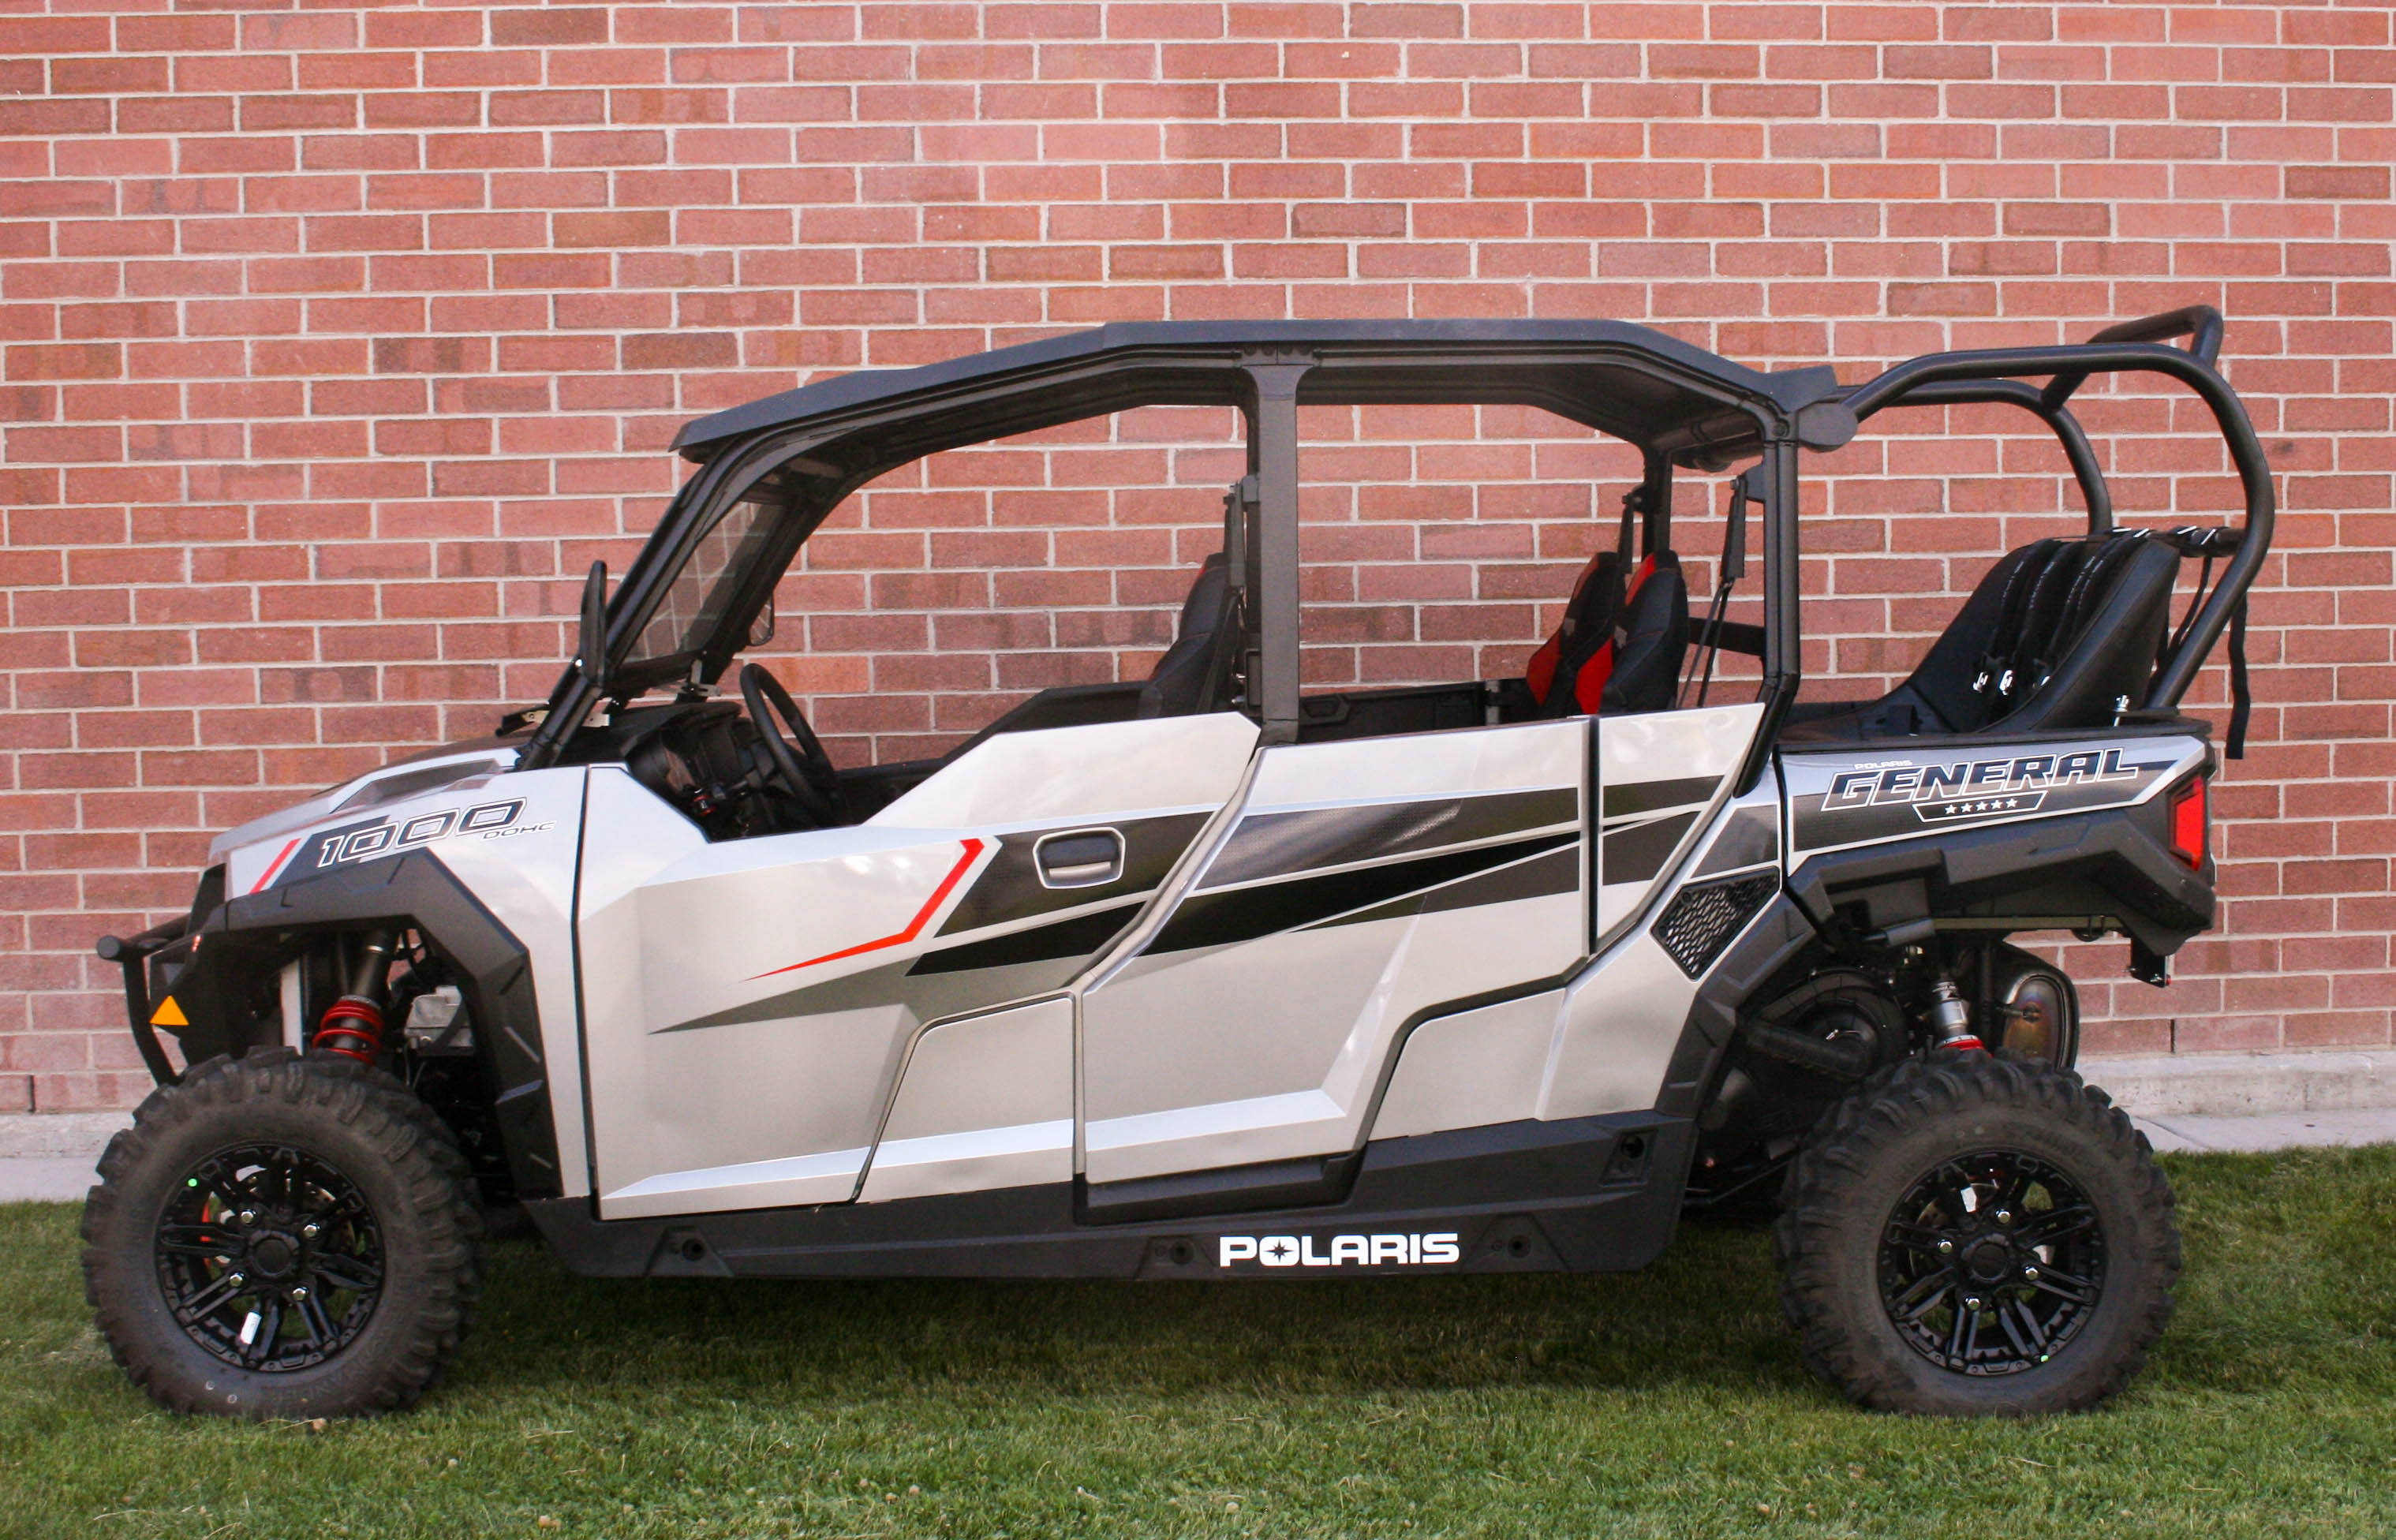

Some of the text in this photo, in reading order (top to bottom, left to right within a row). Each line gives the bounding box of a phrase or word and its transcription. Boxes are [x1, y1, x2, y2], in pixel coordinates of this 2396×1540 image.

[1821, 747, 2139, 812] GENERAL
[1854, 760, 1913, 770] POLARIS
[317, 797, 527, 868] 1000
[482, 820, 557, 841] DOHC
[1220, 1232, 1460, 1267] POLARIS
